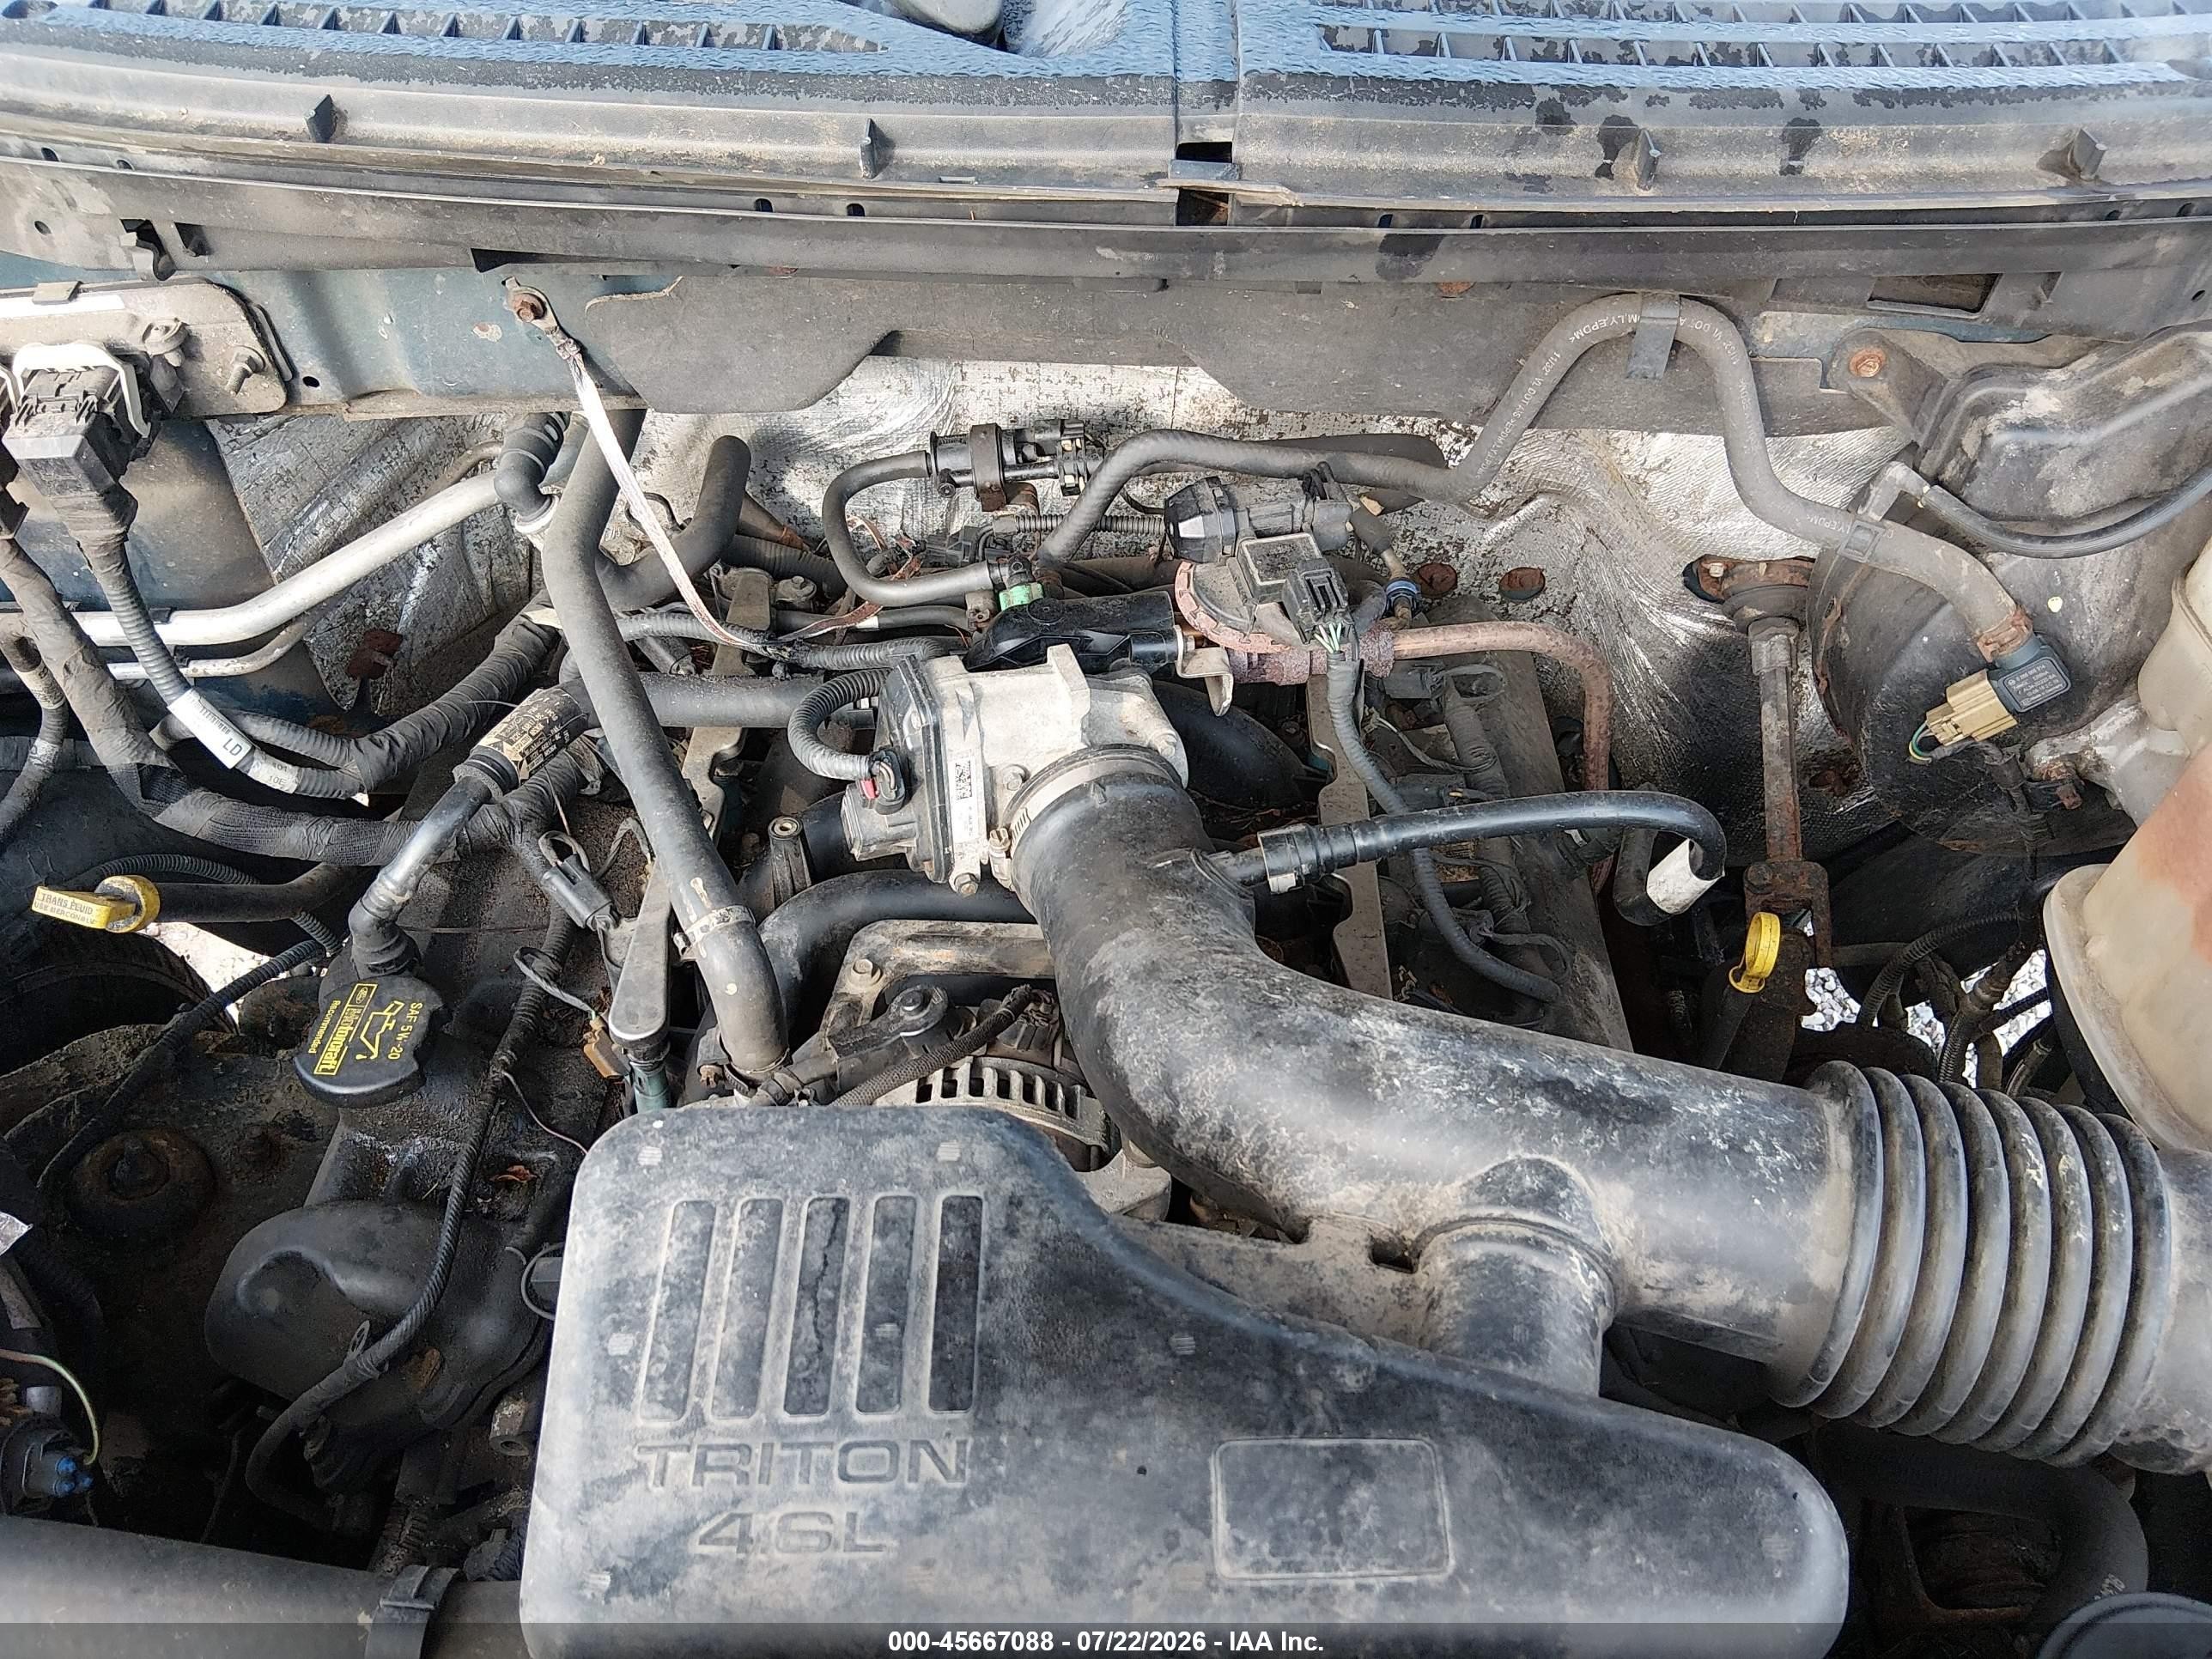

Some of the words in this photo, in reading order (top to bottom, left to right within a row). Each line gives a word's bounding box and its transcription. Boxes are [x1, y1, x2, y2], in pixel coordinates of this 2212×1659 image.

[1568, 313, 1641, 343] M,LY,EPDM<
[222, 738, 243, 757] LD
[40, 892, 69, 908] TRANS
[70, 900, 93, 915] FLUID
[307, 999, 341, 1054] Recommended
[319, 1007, 363, 1073] Motorcraft
[636, 1437, 969, 1488] TRITON
